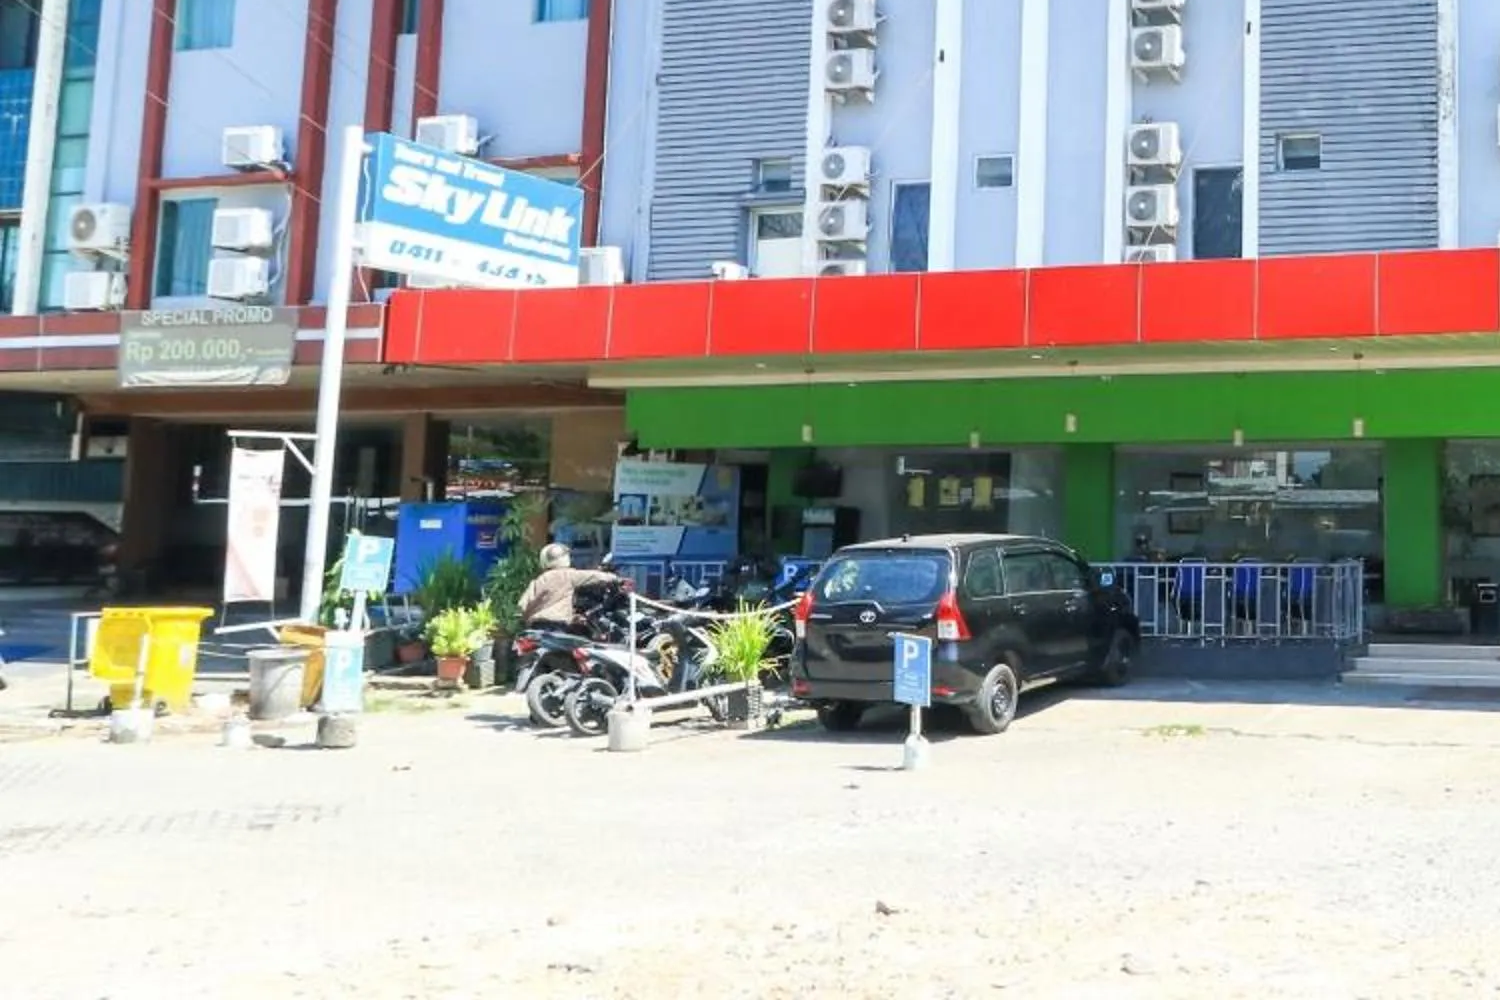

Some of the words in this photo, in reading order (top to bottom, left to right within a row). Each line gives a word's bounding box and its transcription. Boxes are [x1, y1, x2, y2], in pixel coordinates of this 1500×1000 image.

[141, 309, 209, 326] SPECIAL
[212, 307, 273, 325] PROMO
[126, 341, 153, 367] Rp
[902, 639, 920, 669] P
